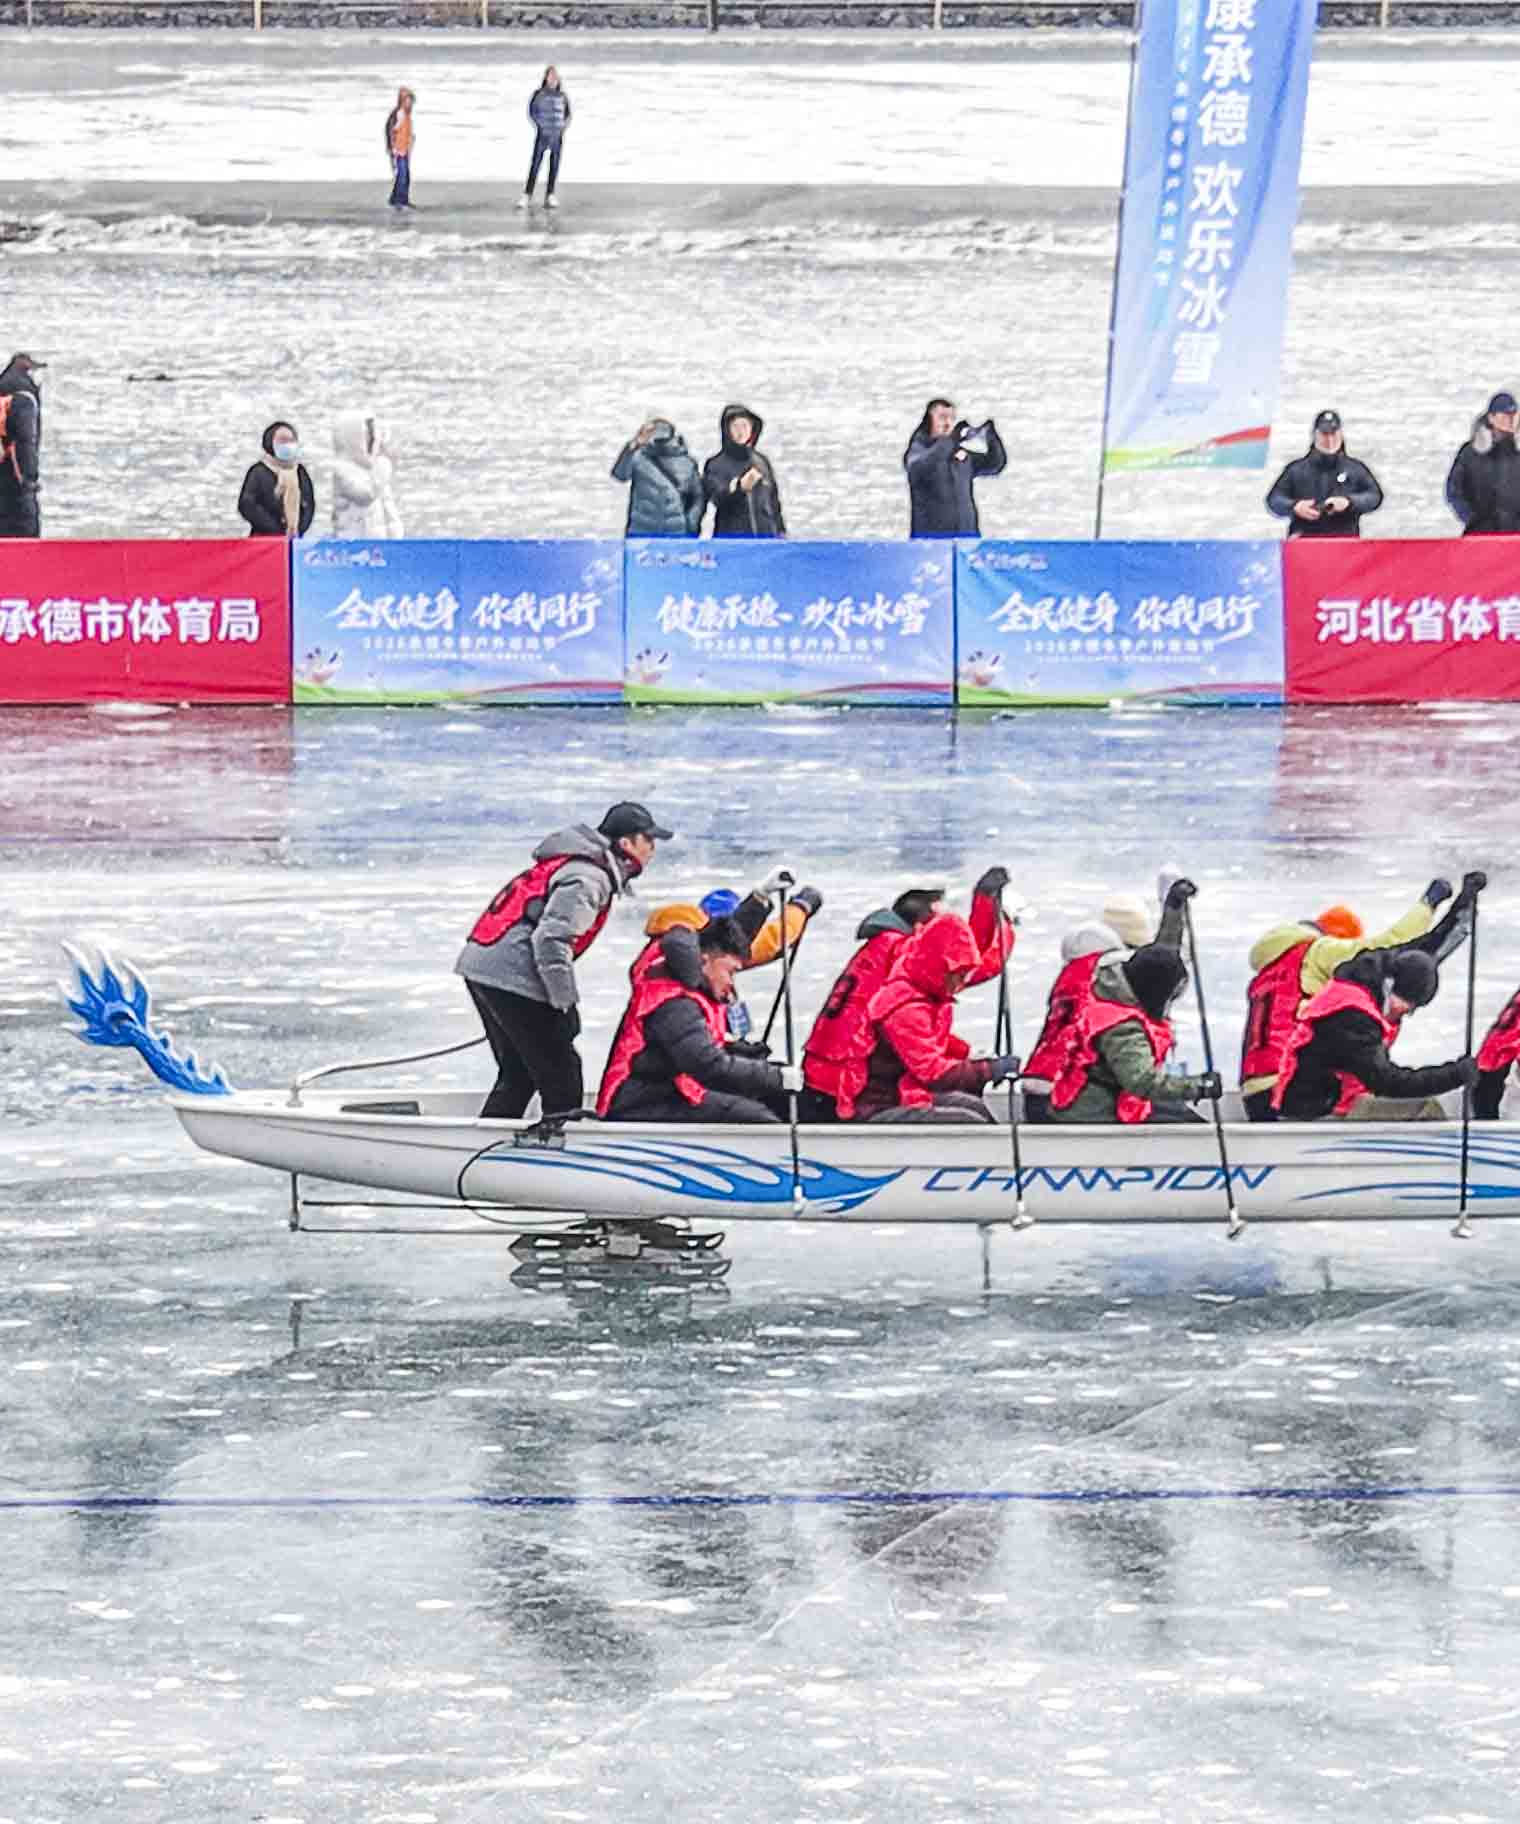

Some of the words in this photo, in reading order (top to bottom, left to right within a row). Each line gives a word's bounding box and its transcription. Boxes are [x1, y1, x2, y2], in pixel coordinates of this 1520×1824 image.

[1170, 160, 1244, 385] 欢乐冰雪
[326, 587, 459, 630] 全民健身
[471, 592, 602, 641] 你我同行
[989, 591, 1119, 633] 全民健身
[1131, 594, 1261, 643] 你我同行
[924, 1166, 1276, 1192] CHAMPION
